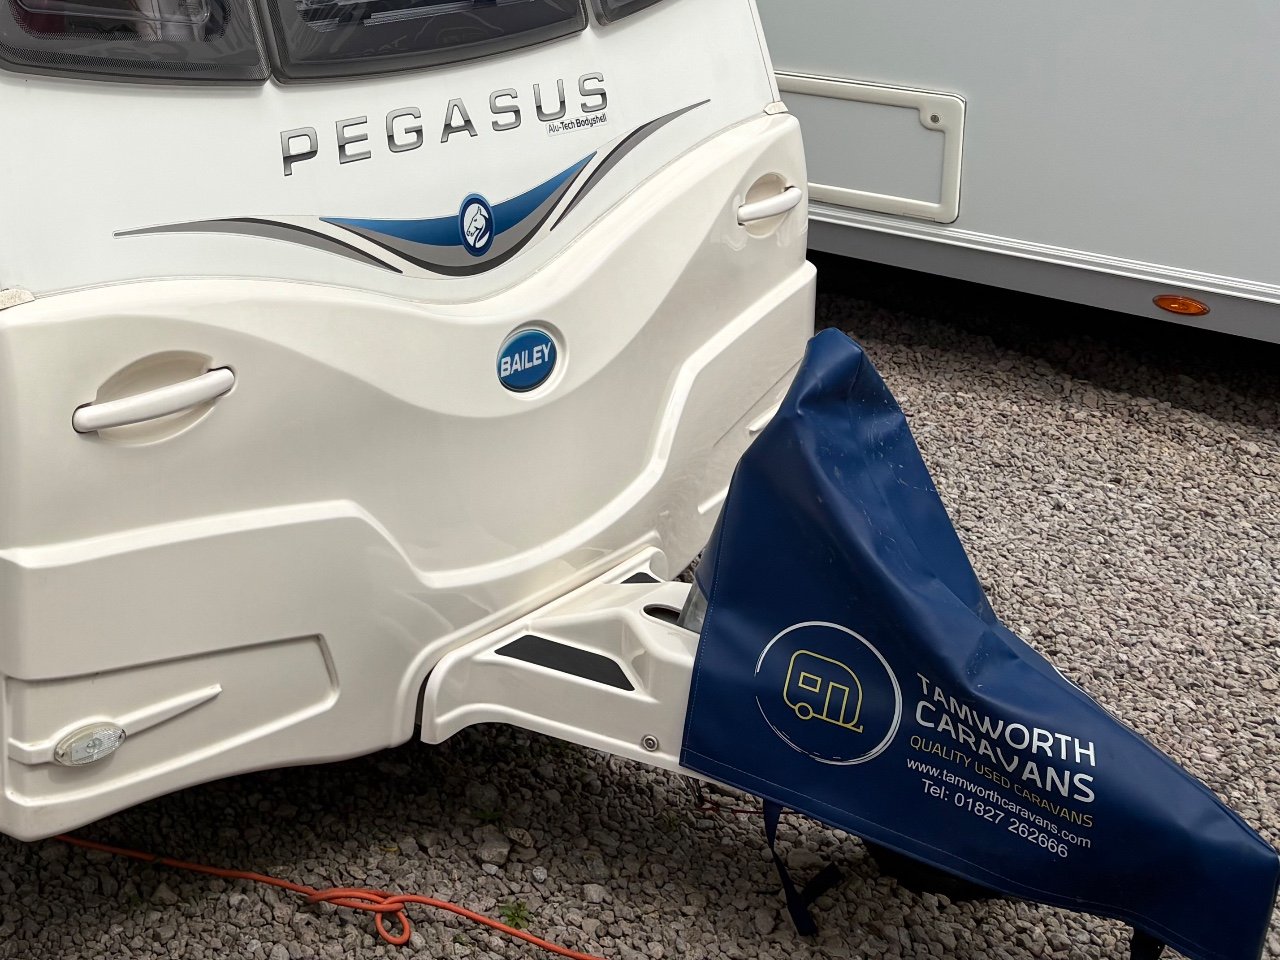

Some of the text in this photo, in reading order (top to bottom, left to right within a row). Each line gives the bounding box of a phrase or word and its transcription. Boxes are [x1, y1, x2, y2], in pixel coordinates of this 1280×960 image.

[280, 71, 608, 176] PEGASUS
[548, 113, 607, 134] Alu-Tech Bodyshell
[500, 342, 551, 377] BAILEY
[914, 700, 1095, 803] CARAVANS
[916, 672, 1096, 767] TAMWORTH
[906, 758, 1092, 849] www.tamworthcaravans.com
[910, 735, 1093, 828] QUALITY USED CARAVANS
[921, 779, 1069, 858] Tel: 01827 262666
